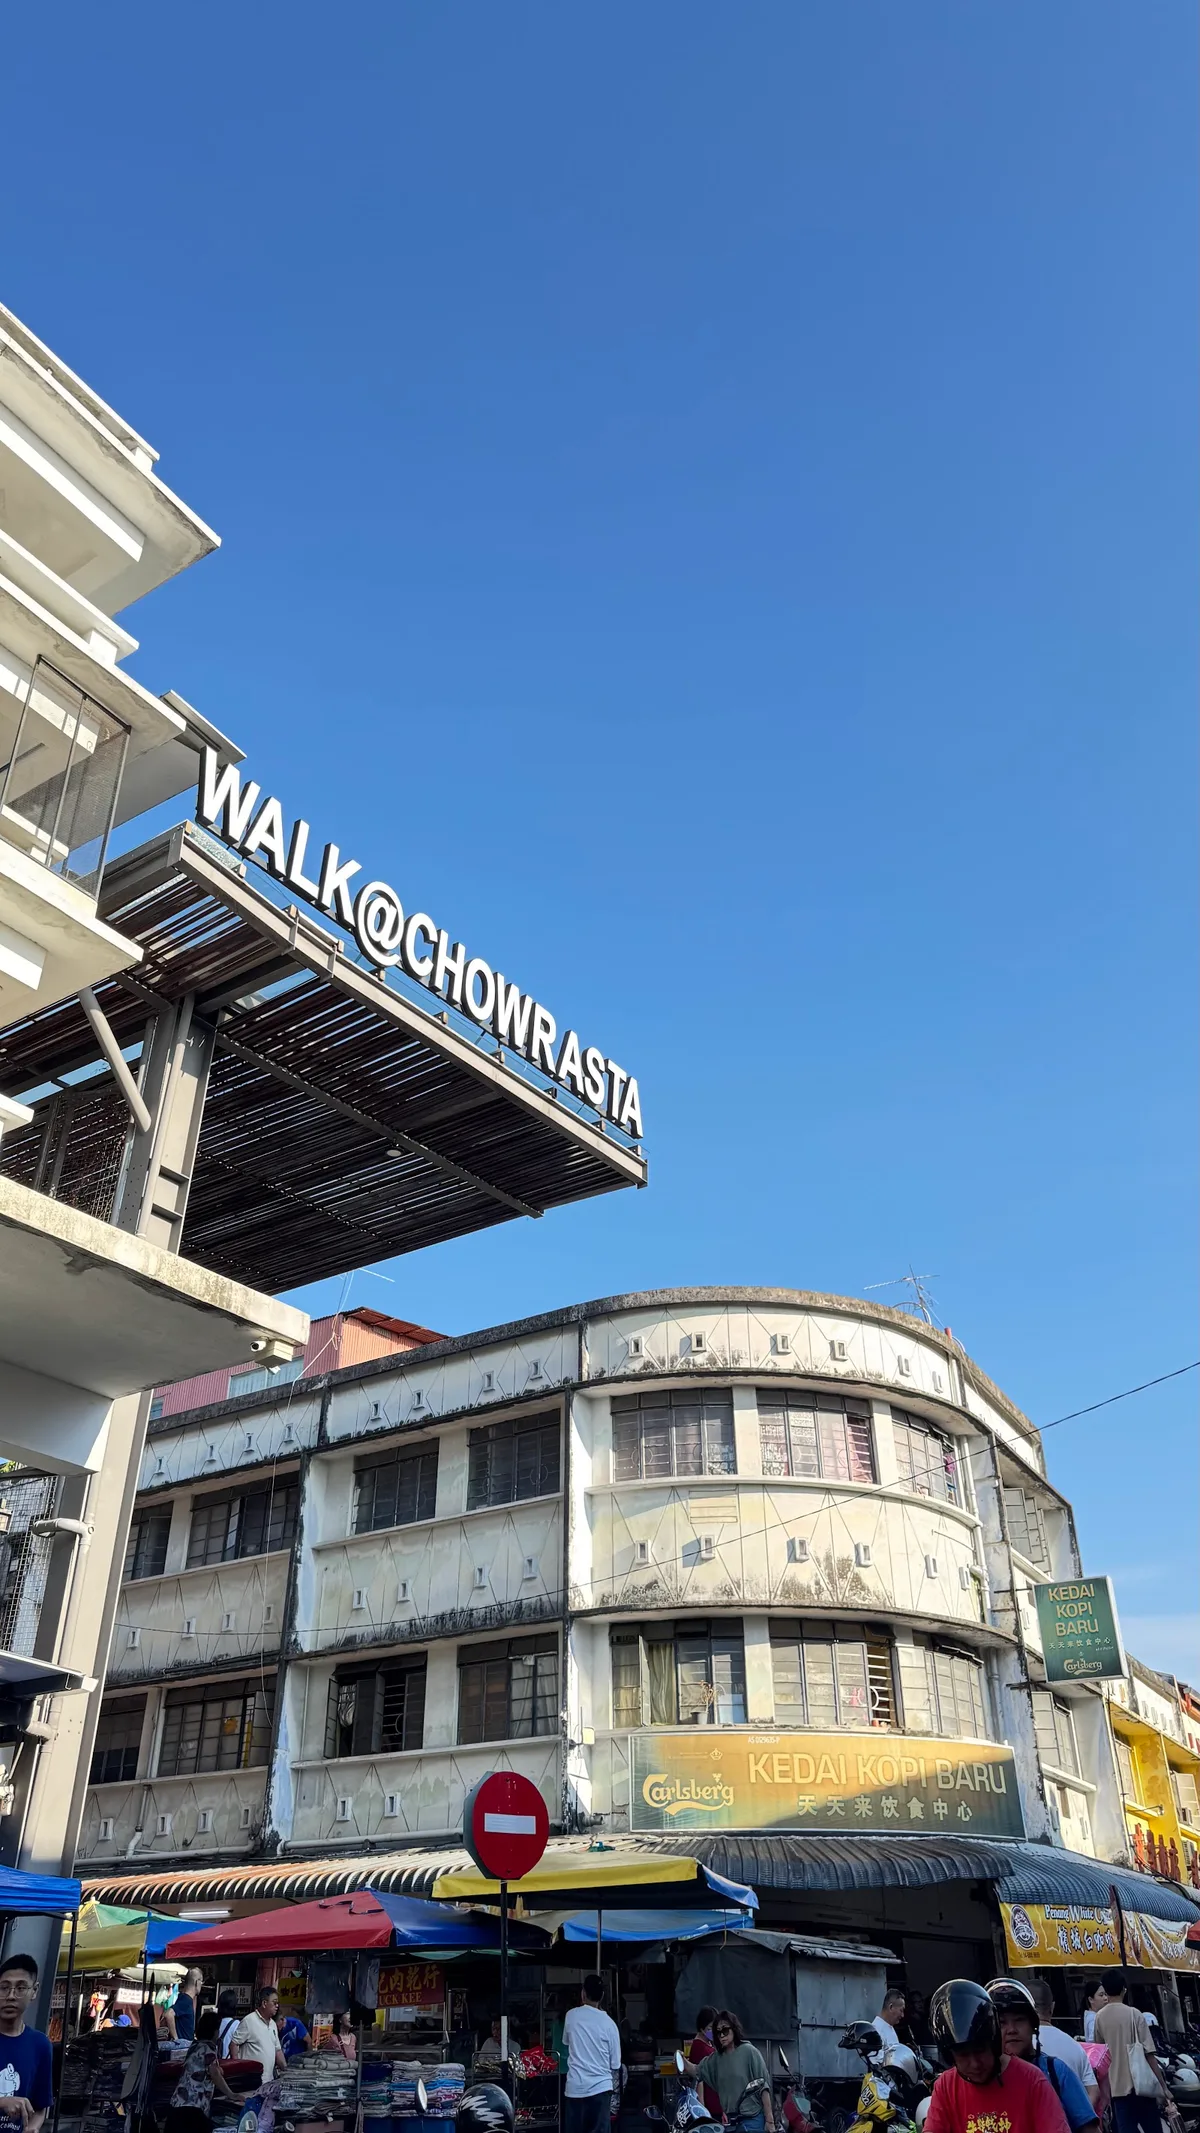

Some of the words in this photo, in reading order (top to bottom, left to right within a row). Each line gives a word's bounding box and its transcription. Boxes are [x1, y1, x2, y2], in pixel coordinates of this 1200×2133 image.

[195, 746, 644, 1139] WALK@CHOWRASTA
[1048, 1583, 1095, 1602] KEDAI
[1056, 1601, 1093, 1618] KOPI
[1055, 1618, 1099, 1637] BARU
[1063, 1658, 1103, 1674] Carlsberg
[747, 1753, 847, 1785] KEDAI
[857, 1755, 928, 1788] KOPI
[936, 1758, 1008, 1795] BARU
[642, 1773, 735, 1809] Carlsberg
[797, 1794, 973, 1823] 天天来饮食中心
[1044, 1904, 1070, 1923] Penang
[1069, 1905, 1094, 1922] White
[379, 1995, 399, 2006] UCK
[401, 1992, 422, 2004] KEE
